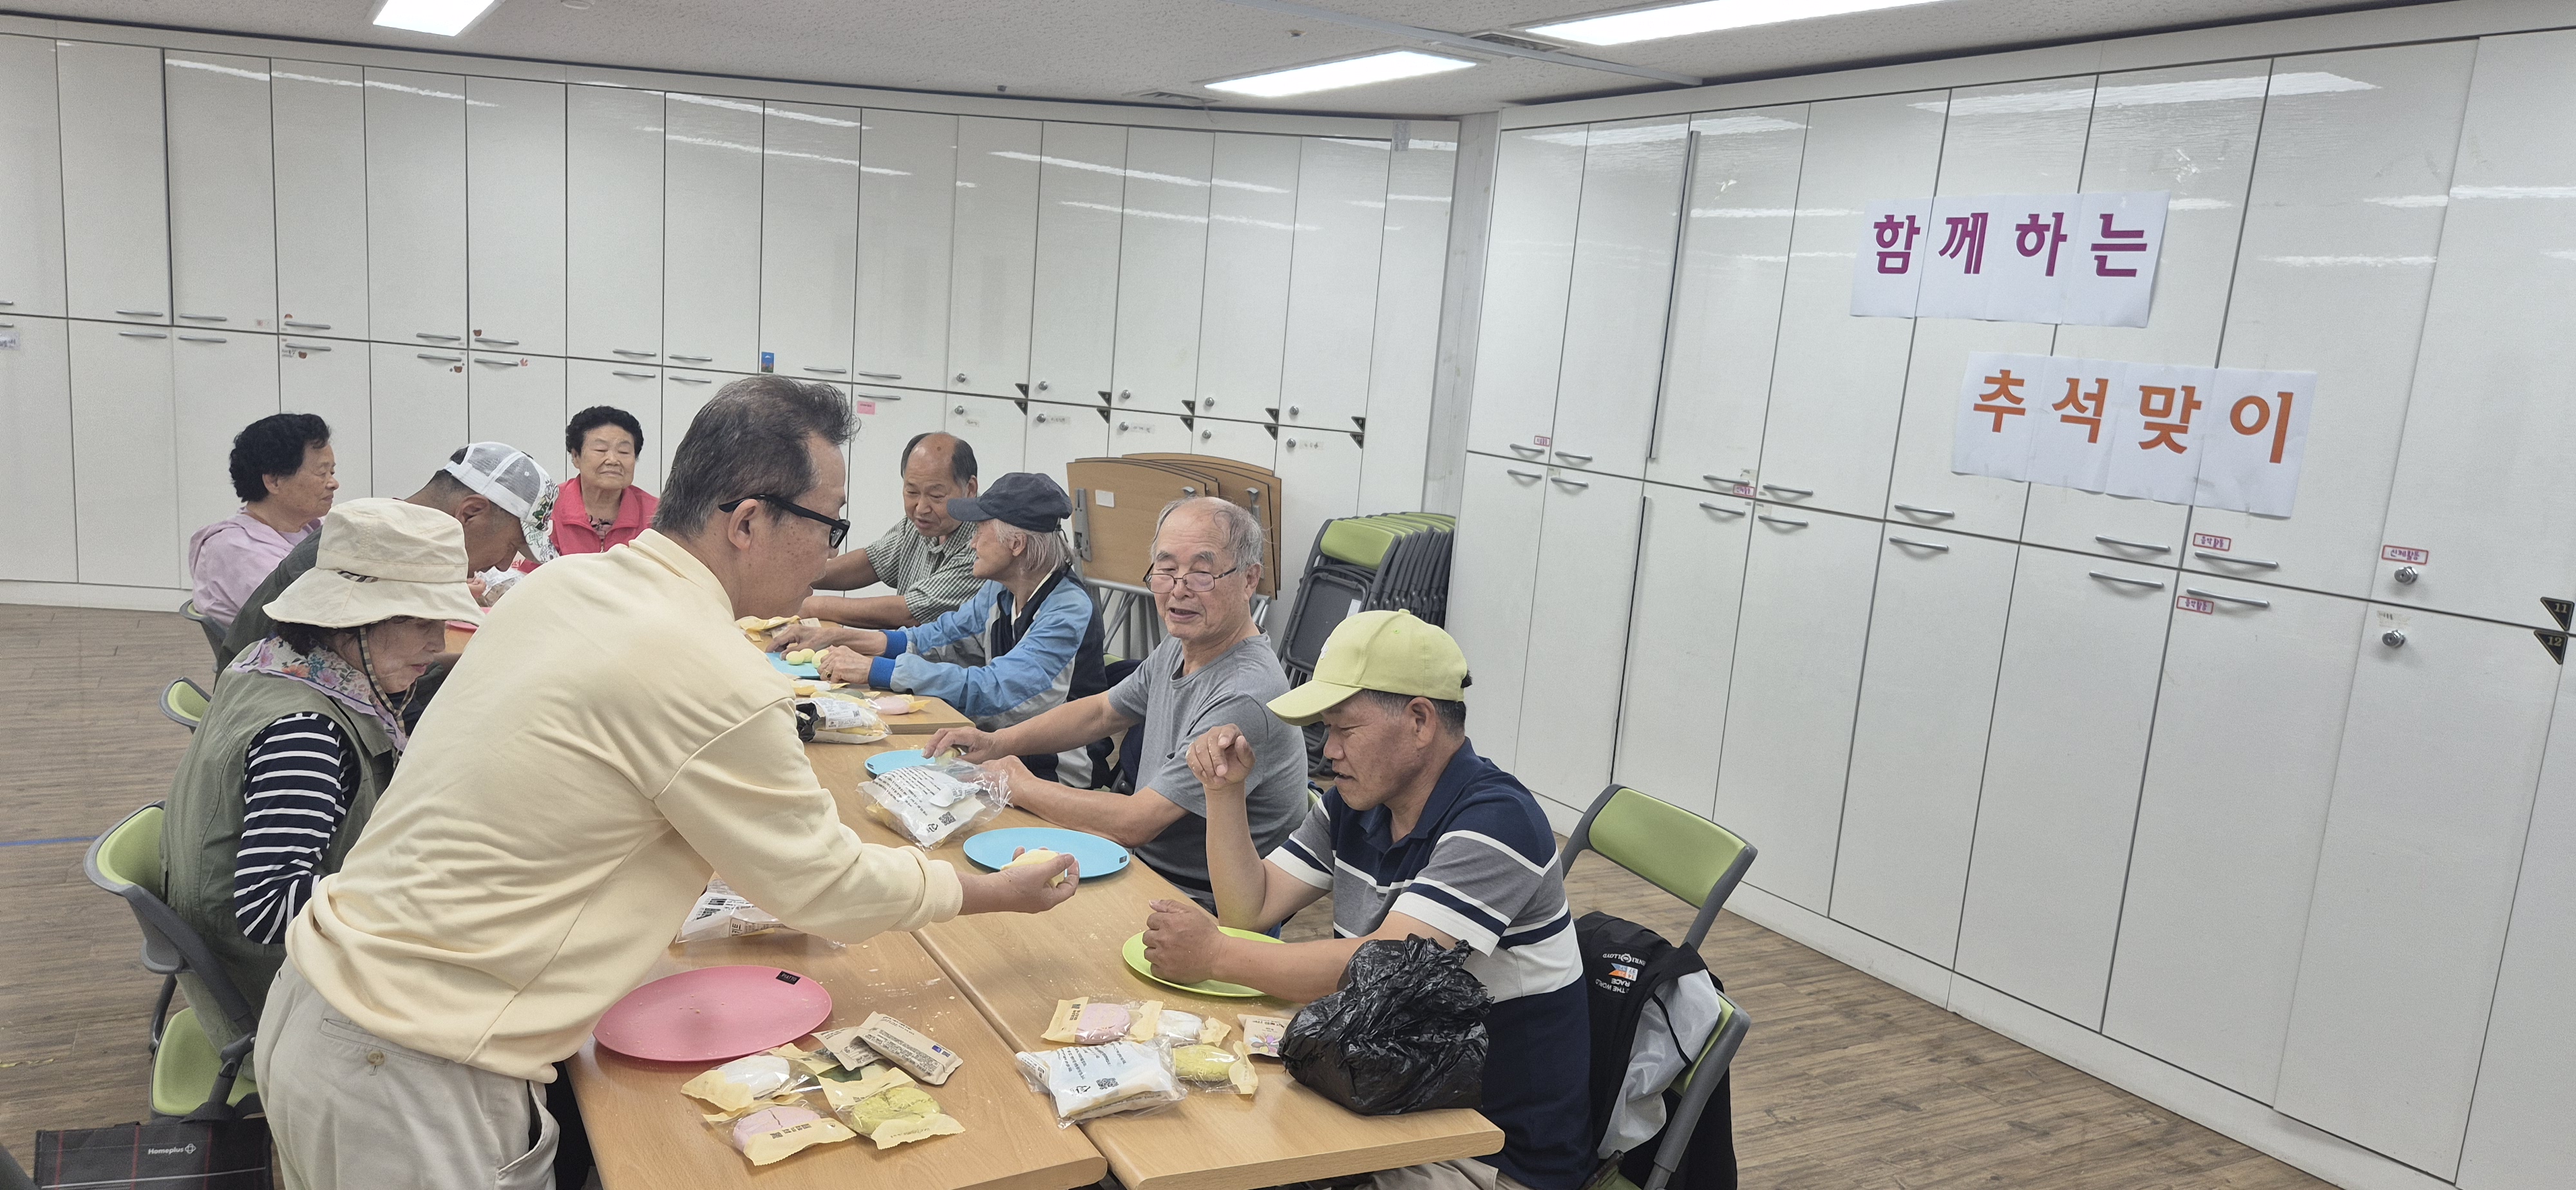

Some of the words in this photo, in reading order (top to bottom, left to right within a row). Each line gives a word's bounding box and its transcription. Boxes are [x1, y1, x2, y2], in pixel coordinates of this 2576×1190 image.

[2554, 603, 2568, 614] 11
[2547, 636, 2562, 647] 12
[1595, 979, 1611, 990] WORLD
[1611, 978, 1631, 987] RACE
[147, 1146, 184, 1155] Homeplus
